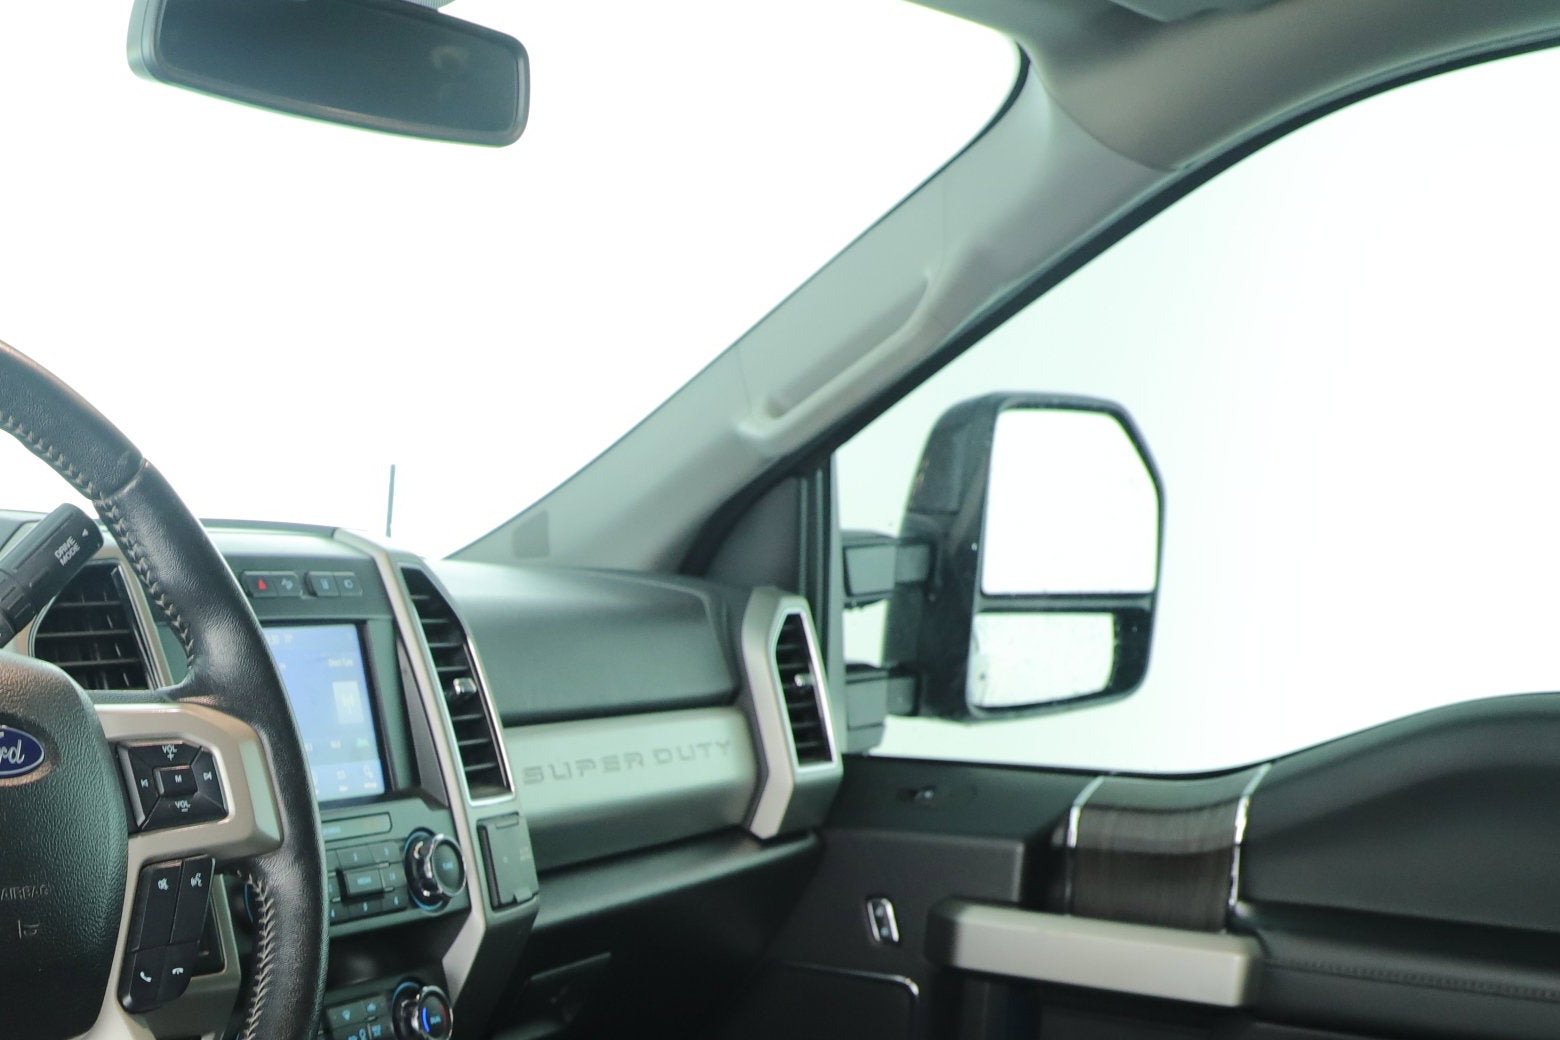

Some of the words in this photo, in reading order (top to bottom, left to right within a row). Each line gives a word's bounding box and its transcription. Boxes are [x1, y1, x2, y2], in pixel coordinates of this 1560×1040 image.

[54, 535, 76, 559] DRIVE
[60, 542, 81, 566] MODE
[161, 744, 177, 754] VOL
[522, 751, 645, 786] SUPER
[652, 740, 731, 765] DUTY
[174, 774, 183, 783] M
[174, 799, 191, 809] VOL
